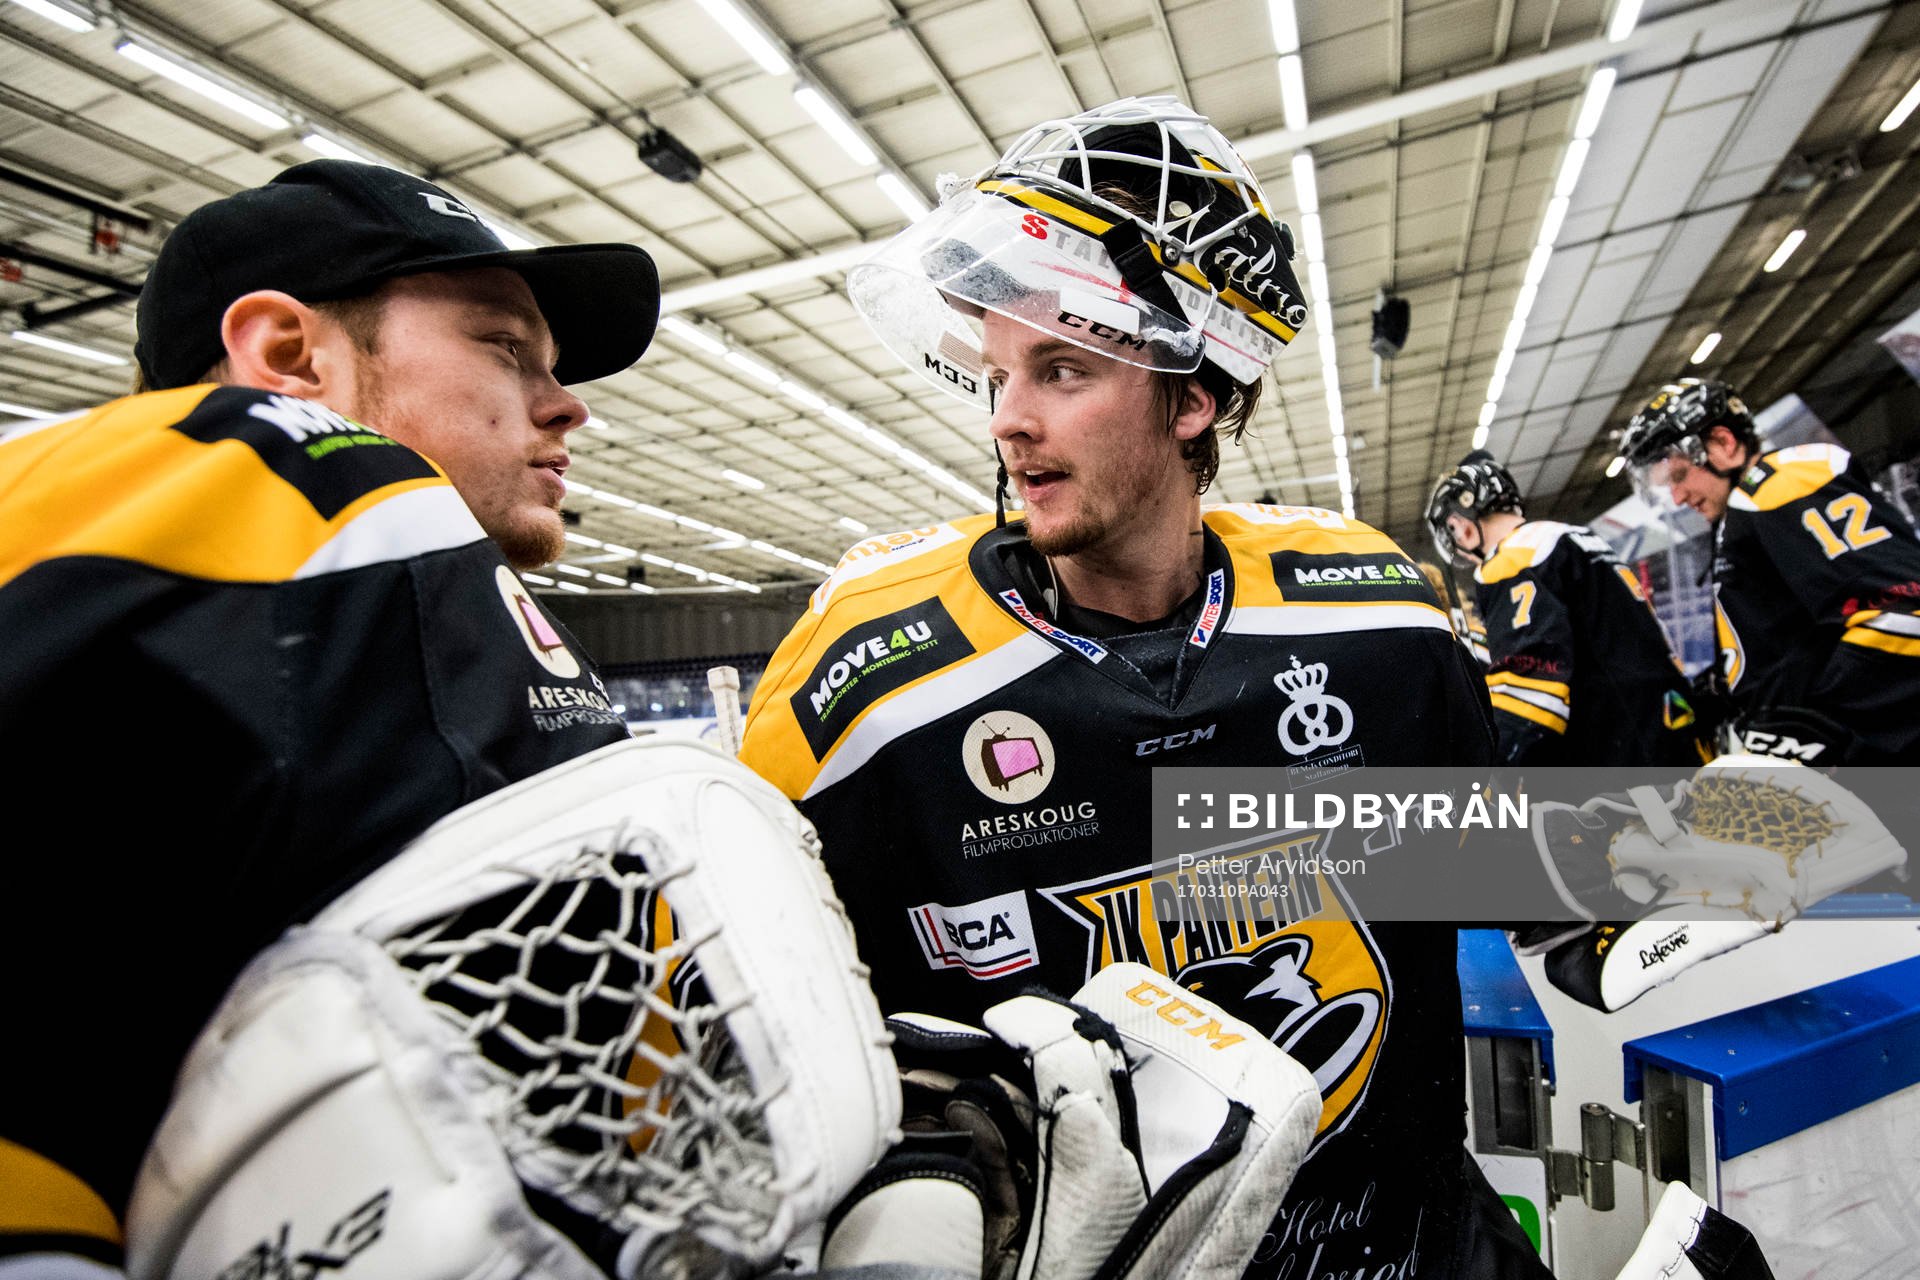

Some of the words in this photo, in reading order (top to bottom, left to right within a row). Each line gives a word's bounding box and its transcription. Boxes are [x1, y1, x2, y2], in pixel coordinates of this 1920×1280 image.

[1058, 310, 1147, 350] CCM
[1801, 492, 1893, 560] 12
[1294, 564, 1419, 584] MOVE4U
[1200, 574, 1223, 631] INTERSPORT
[1511, 580, 1537, 629] 7
[1007, 604, 1104, 659] INTERSPORT
[810, 620, 933, 716] MOVE4U
[820, 677, 860, 722] TRANSPORTER
[862, 650, 911, 676] MONTERING
[916, 639, 939, 654] FLYTT
[1135, 724, 1216, 757] CCM
[1741, 730, 1827, 760] CM
[961, 802, 1097, 842] ARESKOUG
[962, 822, 1100, 860] FILMPRODUKTIONER
[1126, 980, 1248, 1052] CCM
[1252, 1181, 1377, 1264] Hotel
